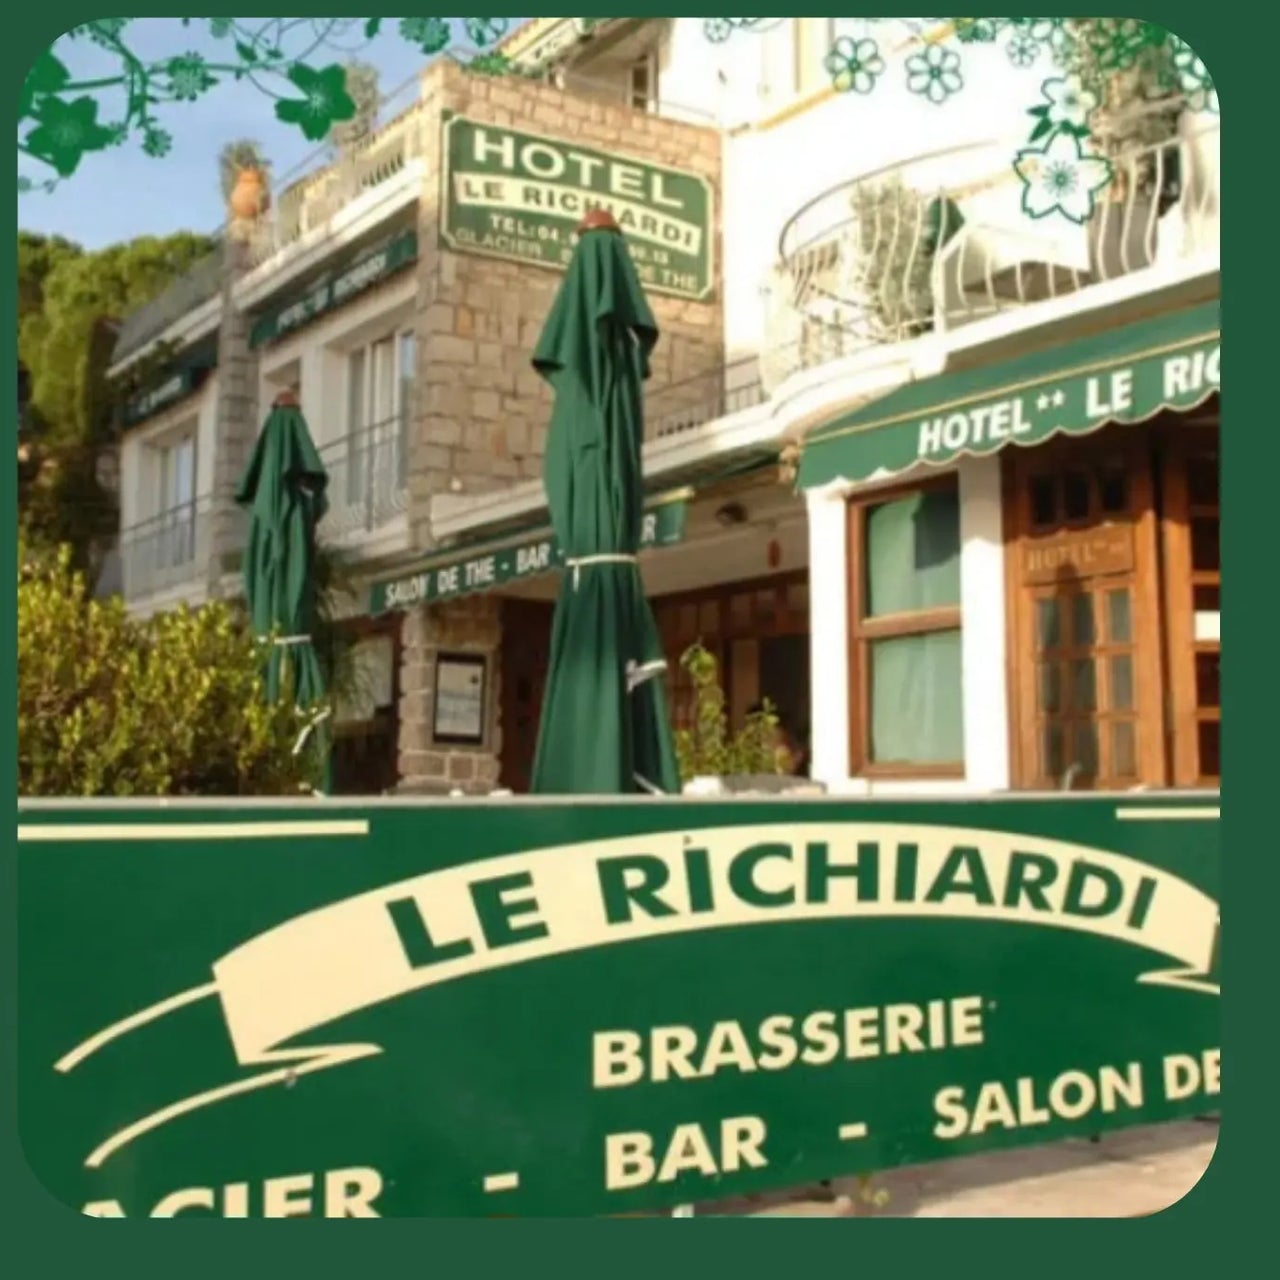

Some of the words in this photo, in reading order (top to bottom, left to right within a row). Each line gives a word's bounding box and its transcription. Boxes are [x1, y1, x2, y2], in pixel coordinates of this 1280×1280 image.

[463, 178, 505, 200] LE
[473, 129, 684, 209] HOTEL
[917, 397, 1031, 456] HOTEL
[1086, 369, 1133, 417] LE
[385, 573, 430, 608] SALON
[437, 567, 459, 593] DE
[465, 556, 495, 586] THE
[516, 543, 550, 573] BAR
[385, 870, 550, 970] LE
[596, 840, 1159, 930] RICHIARDI
[593, 996, 984, 1088] BRASSERIE
[605, 1115, 768, 1191] BAR
[934, 1062, 1143, 1138] SALON
